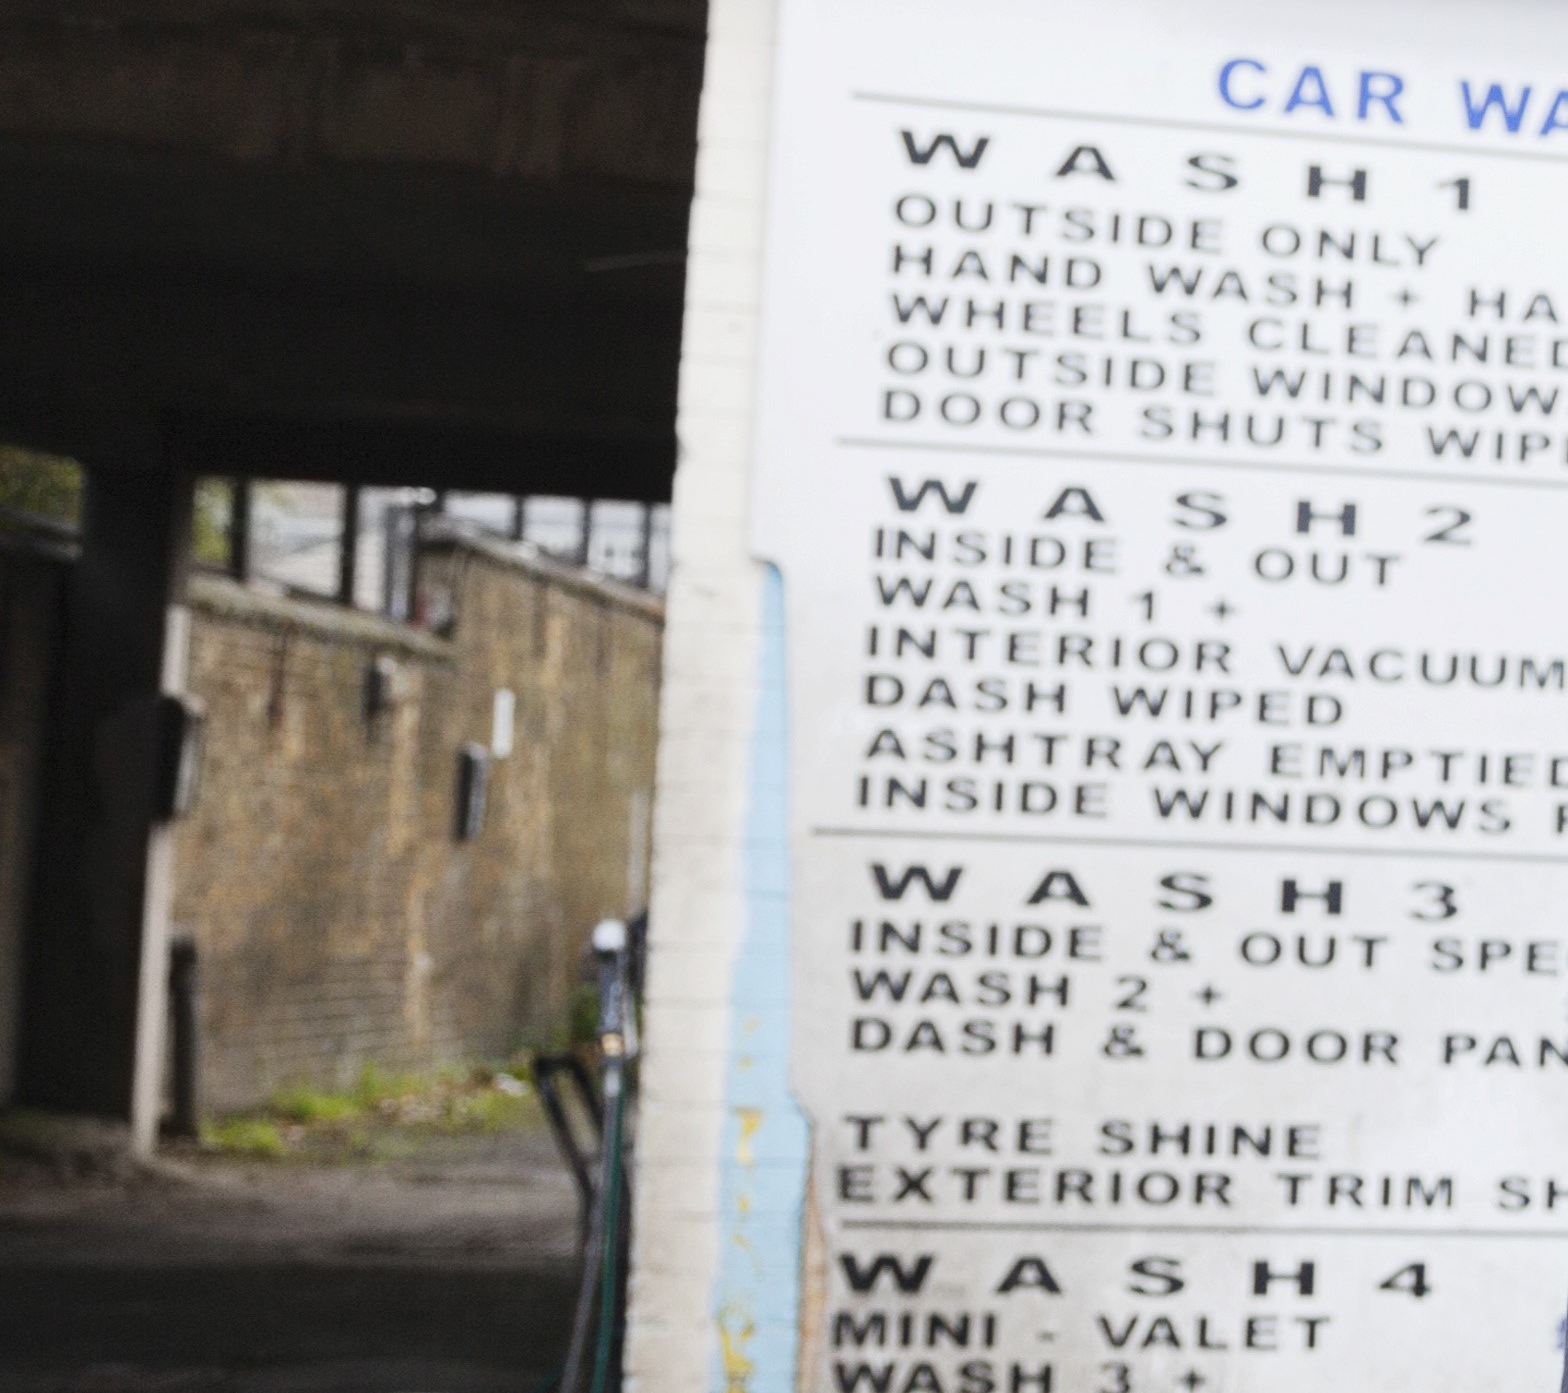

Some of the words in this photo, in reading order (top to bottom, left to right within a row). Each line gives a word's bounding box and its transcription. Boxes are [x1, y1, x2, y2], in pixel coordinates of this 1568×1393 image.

[1217, 59, 1404, 124] CAR
[1436, 176, 1473, 213] 1
[892, 195, 1226, 254] OUTSIDE
[1261, 226, 1436, 266] ONLY
[892, 244, 1102, 288] HAND
[1148, 264, 1353, 309] WASH
[892, 294, 1201, 343] WHEELS
[885, 338, 1220, 398] OUTSIDE
[883, 389, 1093, 433] DOOR
[1142, 408, 1383, 451] SHUTS
[1425, 507, 1471, 543] 2
[874, 527, 1121, 575] INSIDE
[1164, 543, 1206, 578] &
[1254, 549, 1398, 587] OUT
[875, 574, 1089, 619] WASH
[1134, 589, 1156, 623] 1
[867, 625, 1231, 674] INTERIOR
[864, 673, 1066, 714] DASH
[1112, 685, 1343, 726] WIPED
[865, 728, 1223, 773] ASHTRAY
[857, 774, 1105, 817] INSIDE
[1152, 787, 1511, 832] WINDOWS
[1412, 883, 1458, 921] 3
[849, 918, 1101, 961] INSIDE
[1149, 930, 1192, 963] &
[1239, 932, 1387, 969] OUT
[850, 967, 1070, 1009] WASH
[1115, 975, 1148, 1012] 2
[850, 1016, 1056, 1057] DASH
[1101, 1025, 1145, 1058] &
[1193, 1026, 1399, 1065] DOOR
[843, 1115, 1052, 1156] TYRE
[1098, 1120, 1318, 1159] SHINE
[834, 1163, 1232, 1208] EXTERIOR
[1277, 1173, 1453, 1208] TRIM
[1378, 1261, 1432, 1300] 4
[828, 1308, 999, 1353] MINI
[1095, 1314, 1330, 1351] VALET
